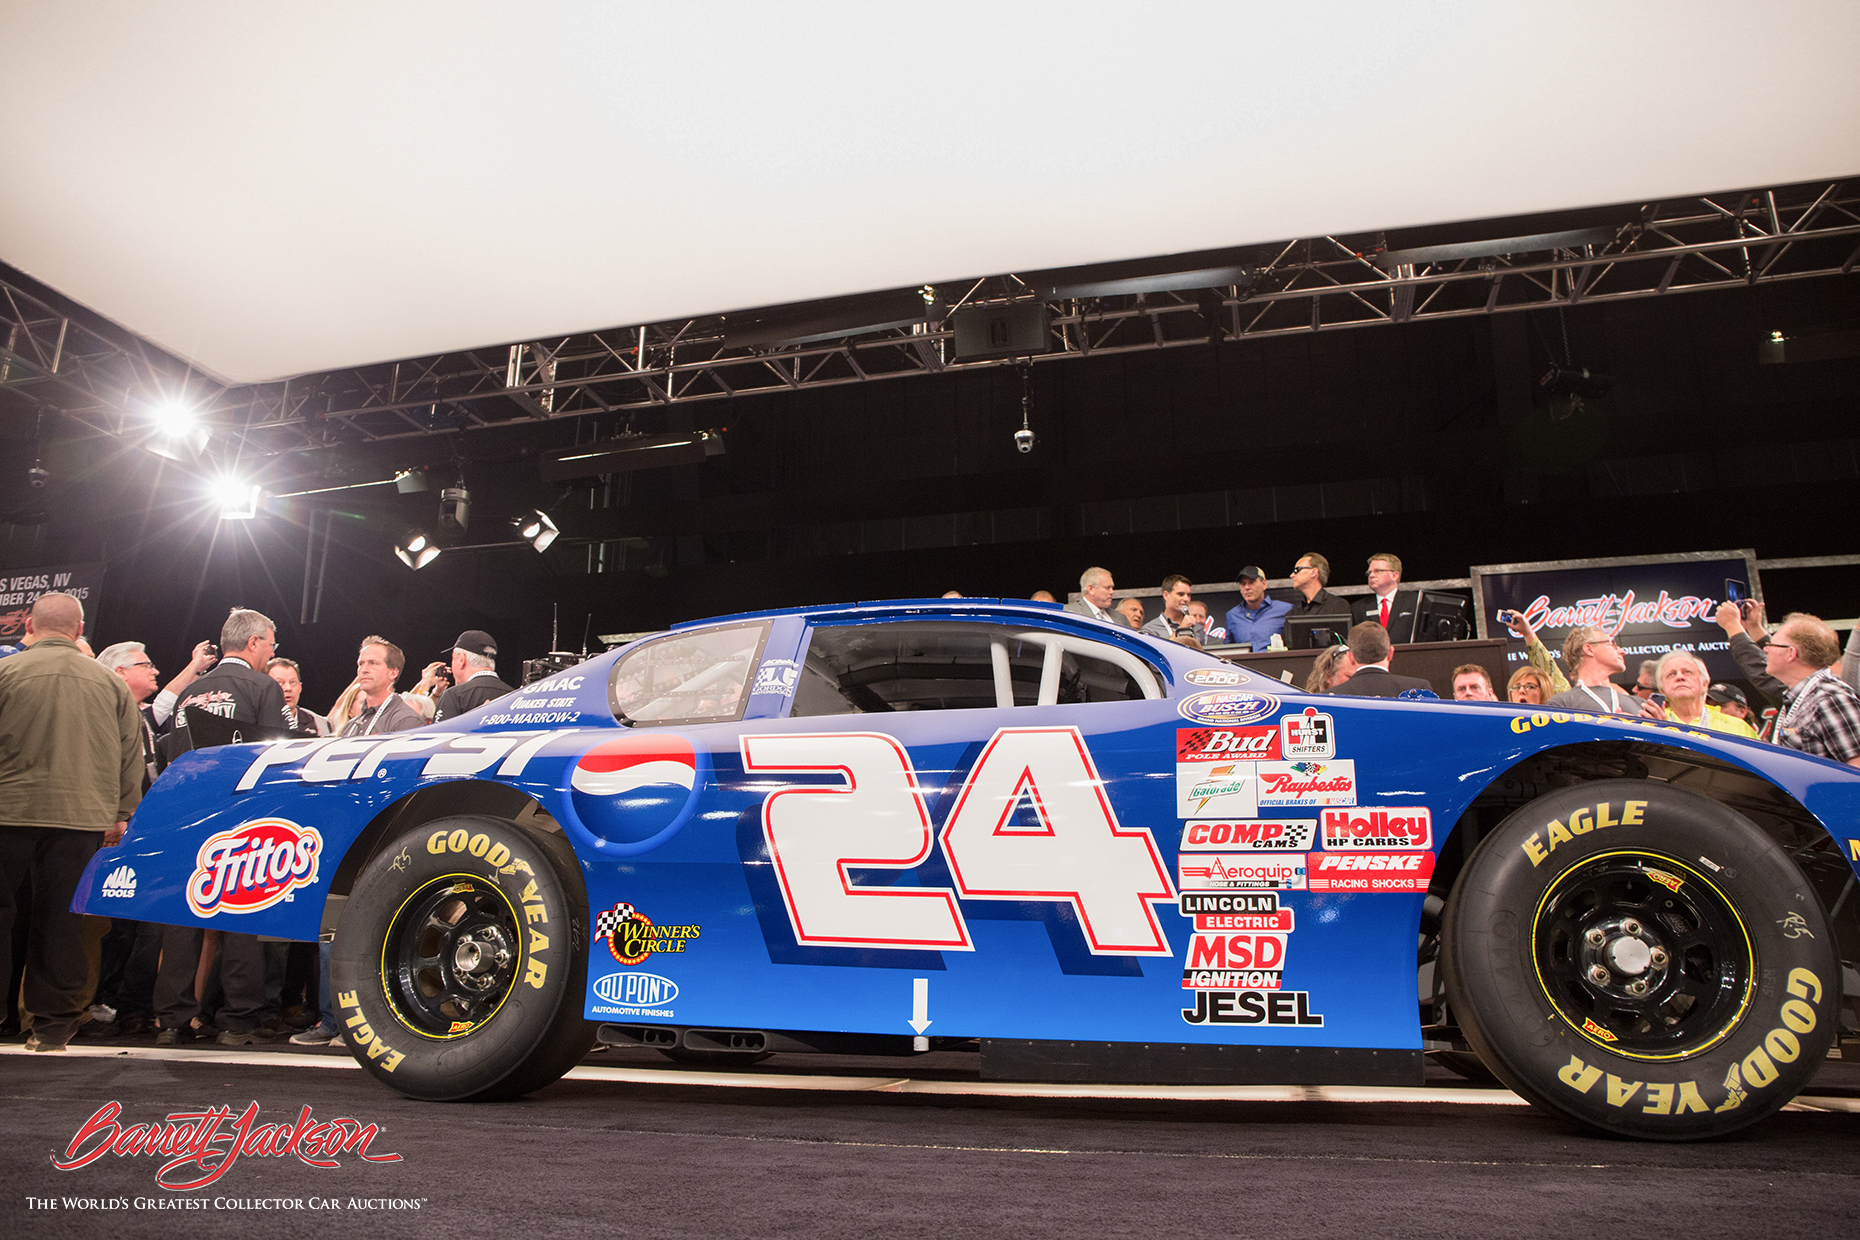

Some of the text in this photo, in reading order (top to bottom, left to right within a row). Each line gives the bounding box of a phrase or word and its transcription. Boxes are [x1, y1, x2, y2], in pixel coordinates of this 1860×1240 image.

[10, 574, 50, 591] VEGAS,
[53, 572, 72, 588] NV
[1508, 589, 1719, 639] Barrett-Jackson
[1621, 644, 1671, 655] OLLECTOR
[523, 676, 585, 694] GMAC
[1194, 674, 1239, 685] 2000
[546, 697, 577, 708] STATE
[1214, 693, 1256, 704] NASCAR
[1199, 701, 1261, 713] BUSCH
[479, 711, 581, 726] 1-800-MARROW-2
[1290, 728, 1324, 737] HURST
[1201, 729, 1278, 753] Bud
[1291, 745, 1326, 753] SHIFTERS
[235, 728, 581, 791] PEPSI
[1221, 752, 1267, 760] AWARD
[1193, 781, 1241, 797] Gatorade
[1259, 773, 1353, 799] Raybestos
[1260, 798, 1284, 806] OFFICIAL
[1187, 823, 1284, 845] COMP
[1325, 811, 1428, 846] Holley
[1521, 800, 1648, 867] EAGLE
[738, 725, 1180, 957] 24
[1252, 839, 1299, 848] CAMS
[1327, 837, 1410, 846] HP CARBS
[192, 835, 314, 905] Fritos
[1209, 856, 1293, 880] Aeroquip
[1318, 855, 1424, 871] PENSKE
[102, 865, 137, 889] MAC
[1236, 880, 1270, 888] FITTINGS
[1331, 879, 1415, 888] RACING SHOCKS
[101, 889, 135, 898] TOOLS
[1185, 897, 1272, 911] LINCOLN
[1206, 916, 1279, 928] ELECTRIC
[617, 922, 701, 942] WINNER'S
[624, 938, 686, 958] CIRCLE
[1190, 935, 1283, 969] MSD
[1189, 971, 1278, 988] IGNITION
[591, 1006, 674, 1018] AUTOMOTIVE FINISHES
[1182, 991, 1323, 1025] JESEL
[338, 990, 406, 1073] EAGLE
[453, 1022, 470, 1032] AERO
[1586, 1023, 1611, 1039] AERO
